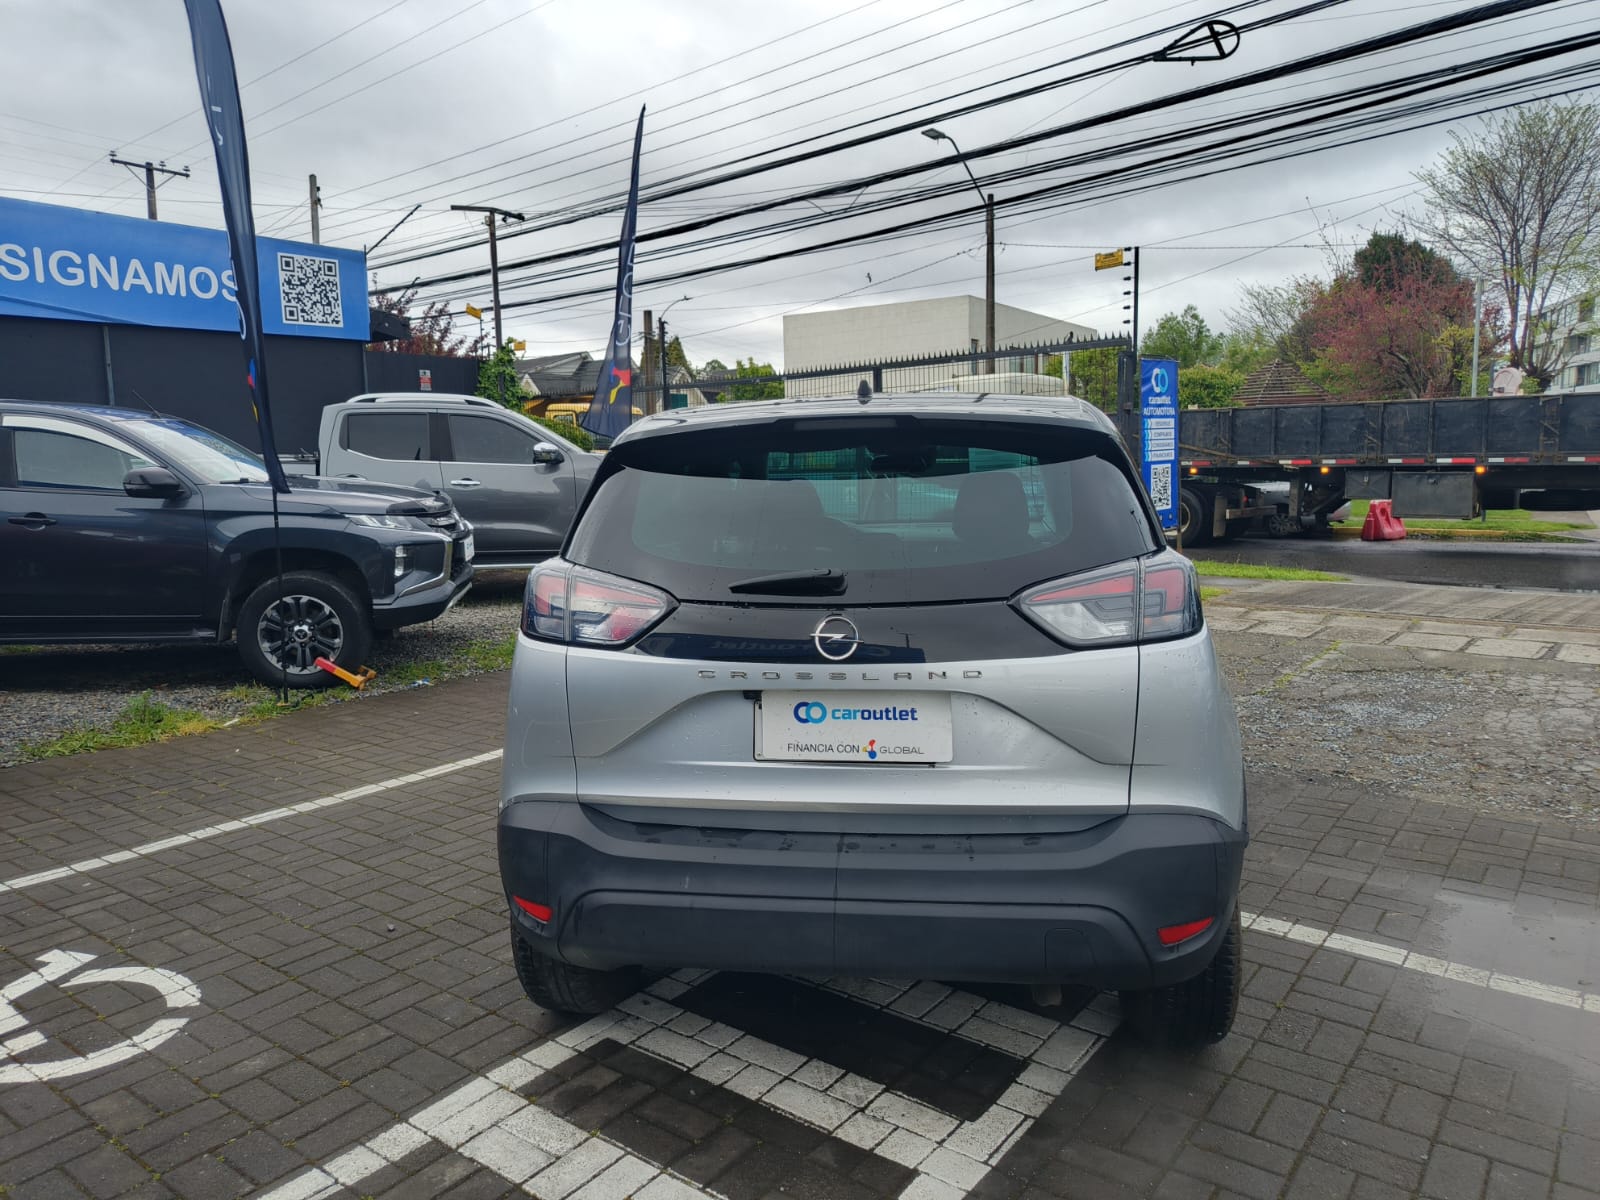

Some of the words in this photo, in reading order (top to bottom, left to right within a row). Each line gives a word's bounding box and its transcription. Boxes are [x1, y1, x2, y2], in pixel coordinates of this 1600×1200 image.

[0, 243, 239, 302] SIGNAMOS
[698, 670, 983, 681] CROSSLAND
[831, 706, 918, 721] caroutlet
[787, 743, 834, 753] FINANCIA
[837, 744, 859, 753] CON
[879, 746, 925, 755] GLOBAL
